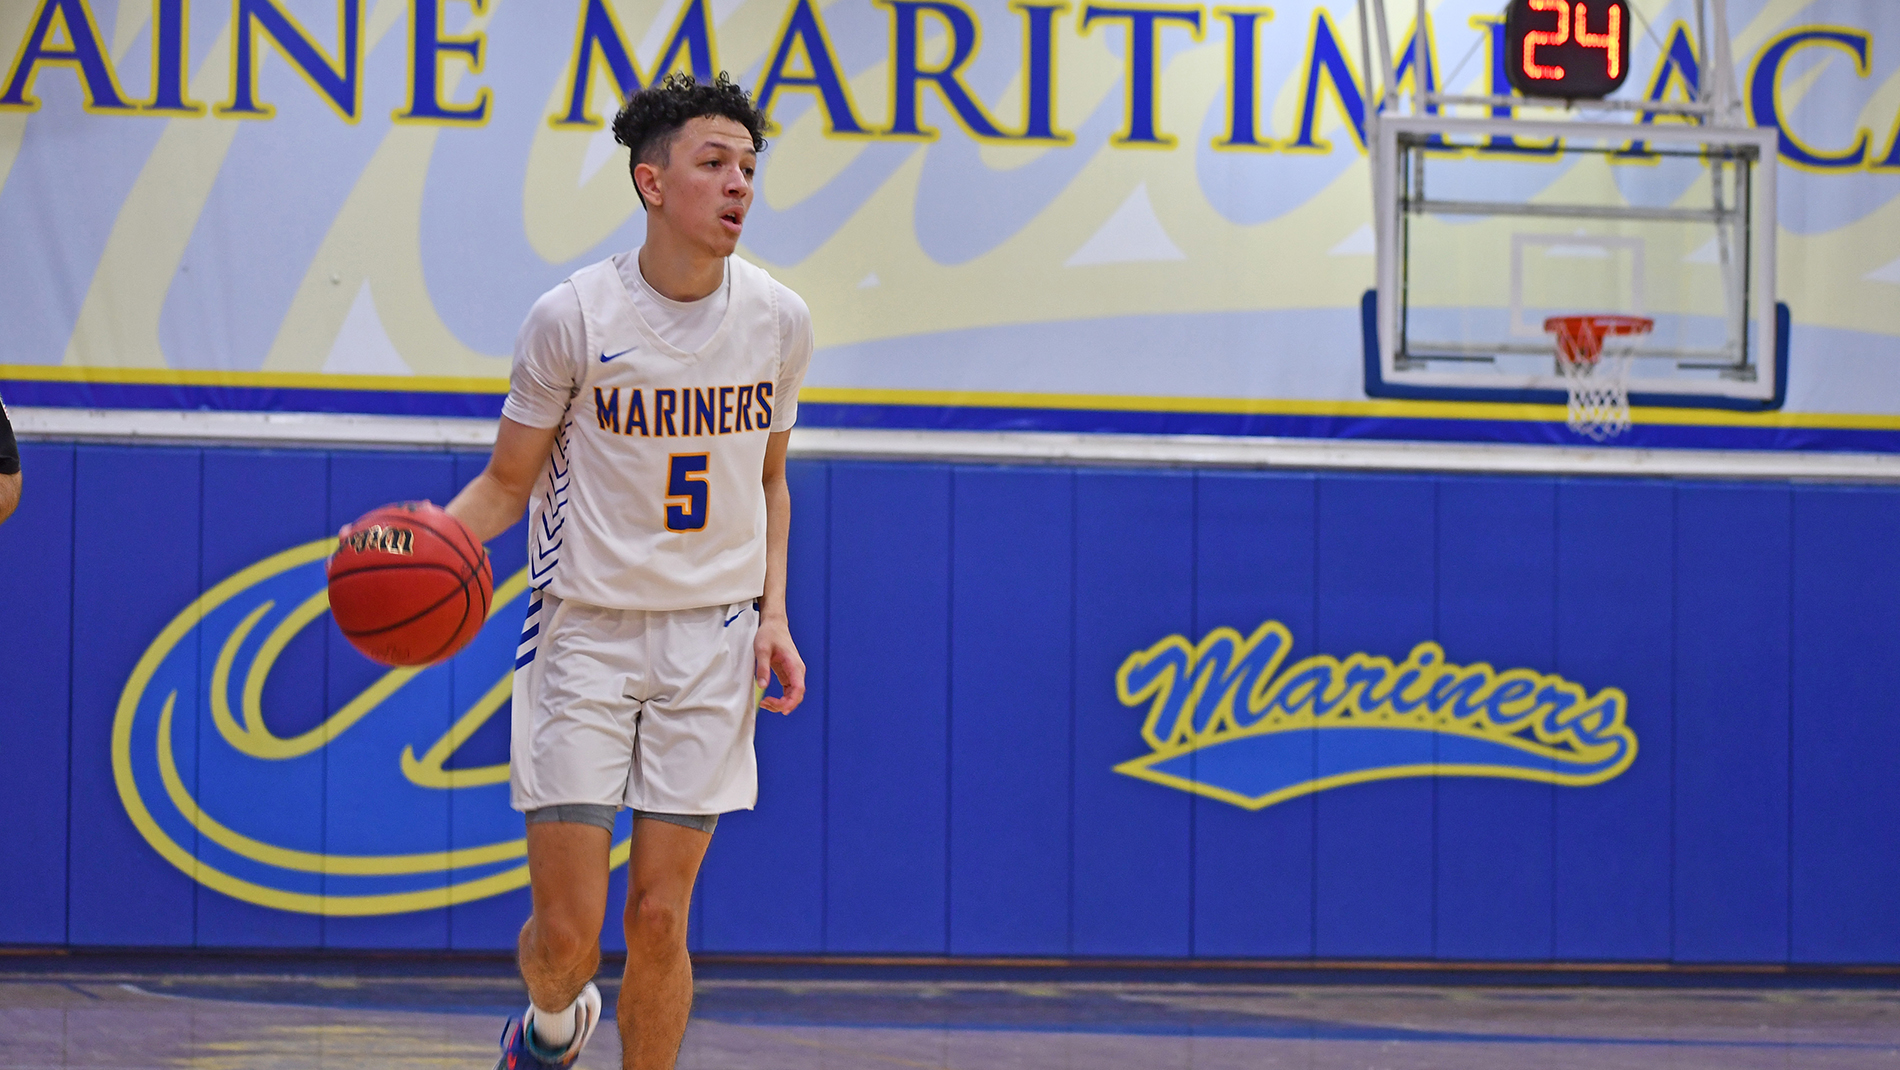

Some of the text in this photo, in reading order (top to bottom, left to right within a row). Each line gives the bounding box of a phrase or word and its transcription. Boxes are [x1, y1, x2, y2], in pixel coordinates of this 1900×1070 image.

[1522, 0, 1622, 80] 24
[593, 380, 774, 438] MARINERS
[663, 451, 711, 534] 5
[1115, 619, 1630, 752] Mariners
